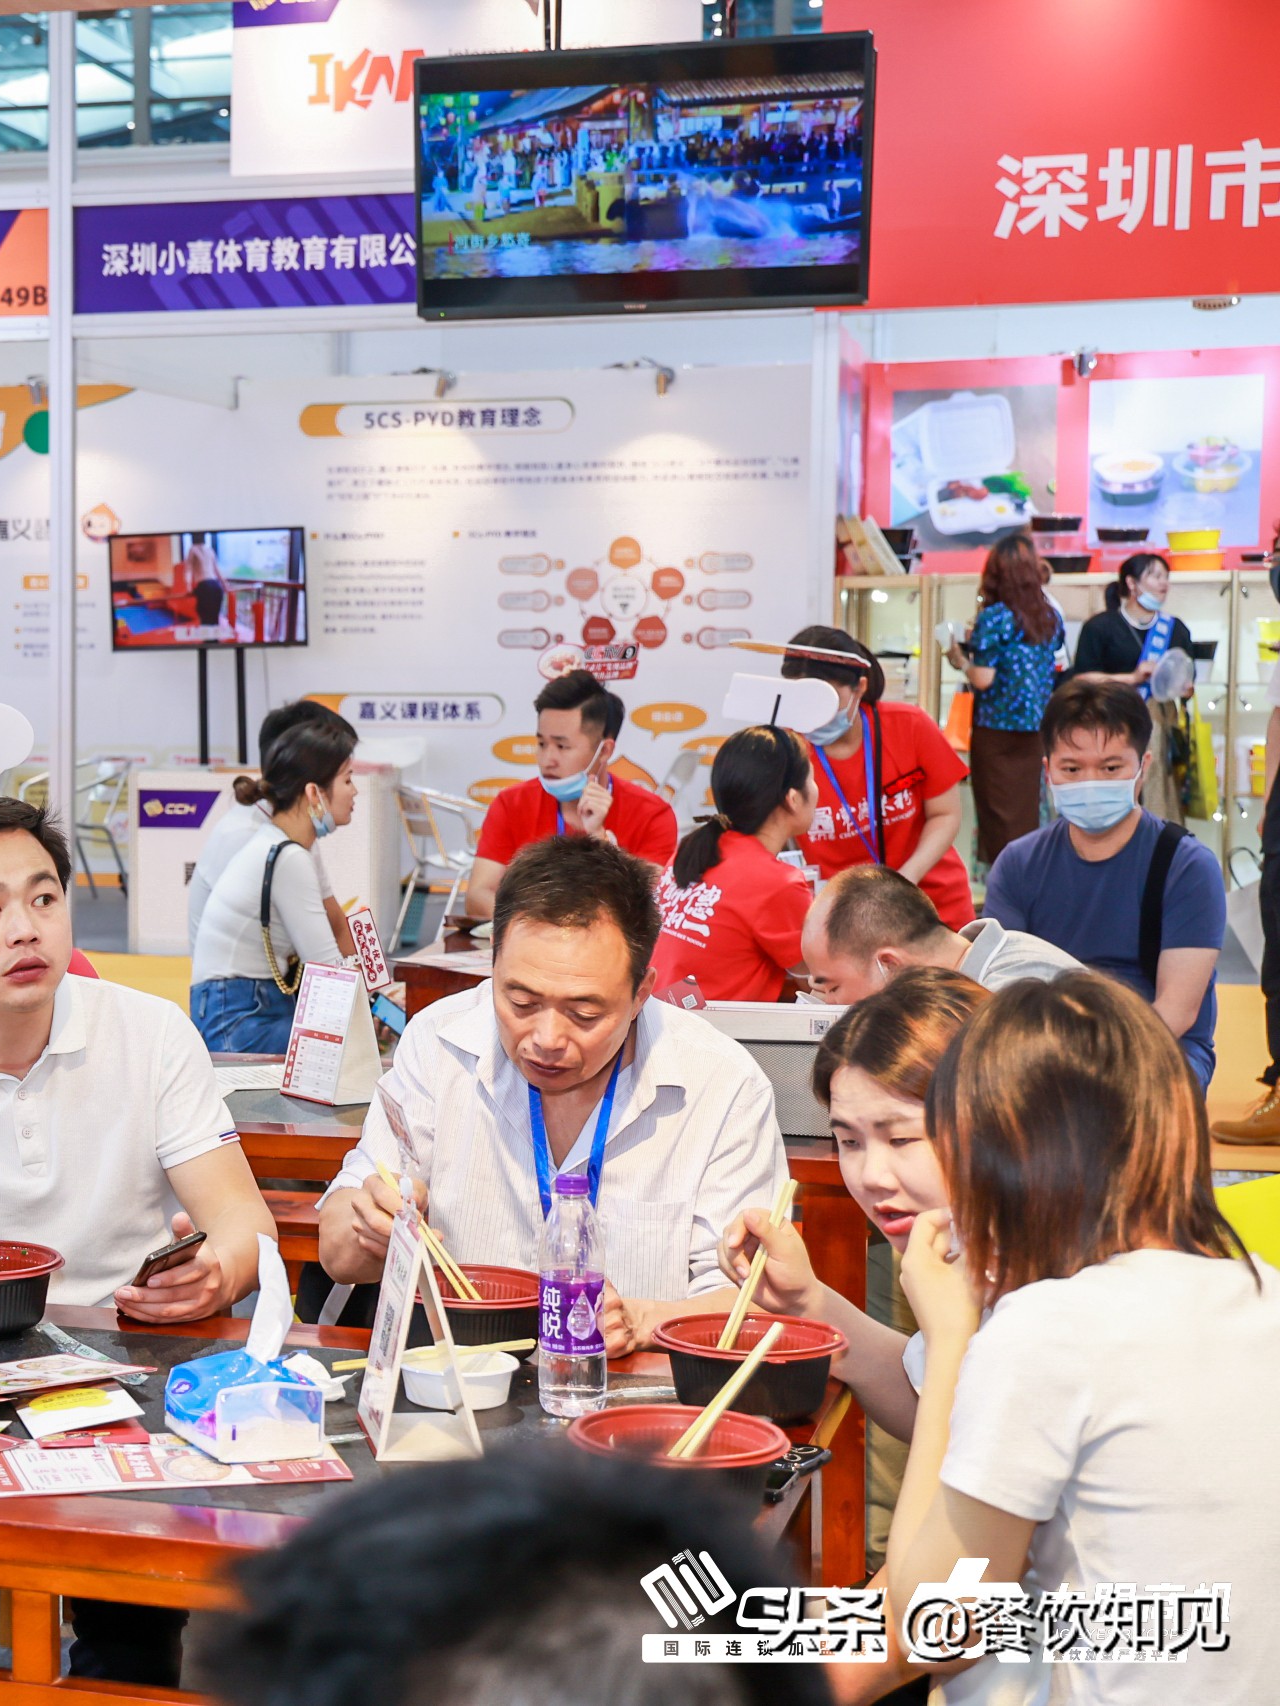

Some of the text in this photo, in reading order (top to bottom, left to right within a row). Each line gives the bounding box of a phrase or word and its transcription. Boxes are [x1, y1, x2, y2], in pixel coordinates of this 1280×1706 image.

[993, 137, 1280, 240] 深圳市
[101, 232, 417, 277] 深圳小嘉体育教育有限公
[359, 701, 481, 721] 嘉义课程体系
[542, 1285, 561, 1340] 纯悦
